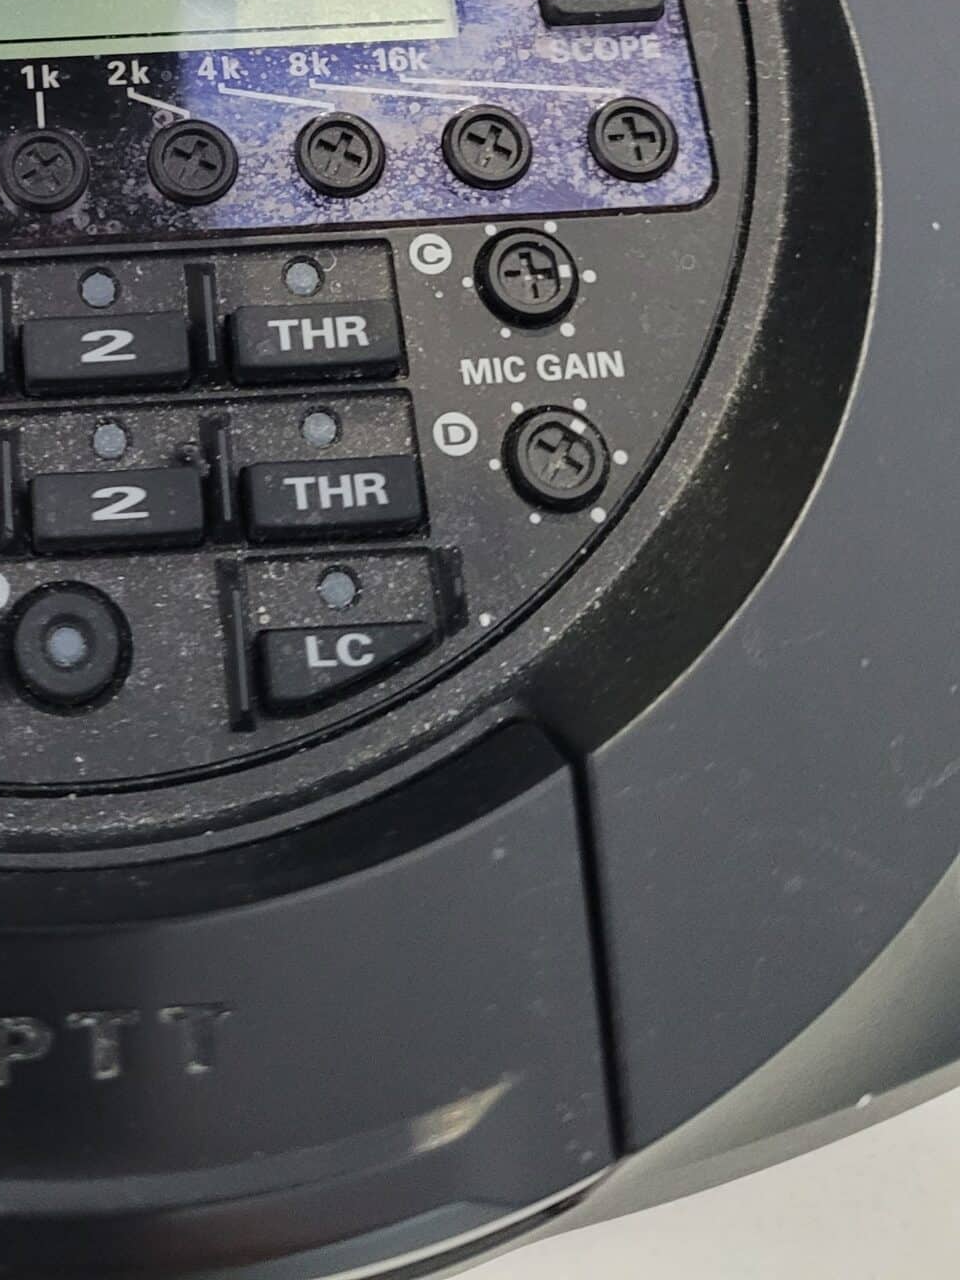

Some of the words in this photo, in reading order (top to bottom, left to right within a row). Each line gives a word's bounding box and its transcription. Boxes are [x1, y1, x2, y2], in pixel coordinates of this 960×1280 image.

[21, 64, 60, 90] 1k
[107, 59, 150, 86] 2k
[197, 56, 240, 82] 4k
[288, 51, 332, 78] 8k
[373, 46, 428, 72] 16k
[549, 36, 662, 64] SCOPE
[80, 328, 137, 363] 2
[267, 315, 369, 352] THR
[461, 354, 531, 386] MIC
[536, 350, 625, 381] GAIN
[90, 485, 149, 521] 2
[283, 471, 390, 511] THR
[305, 632, 376, 669] LC
